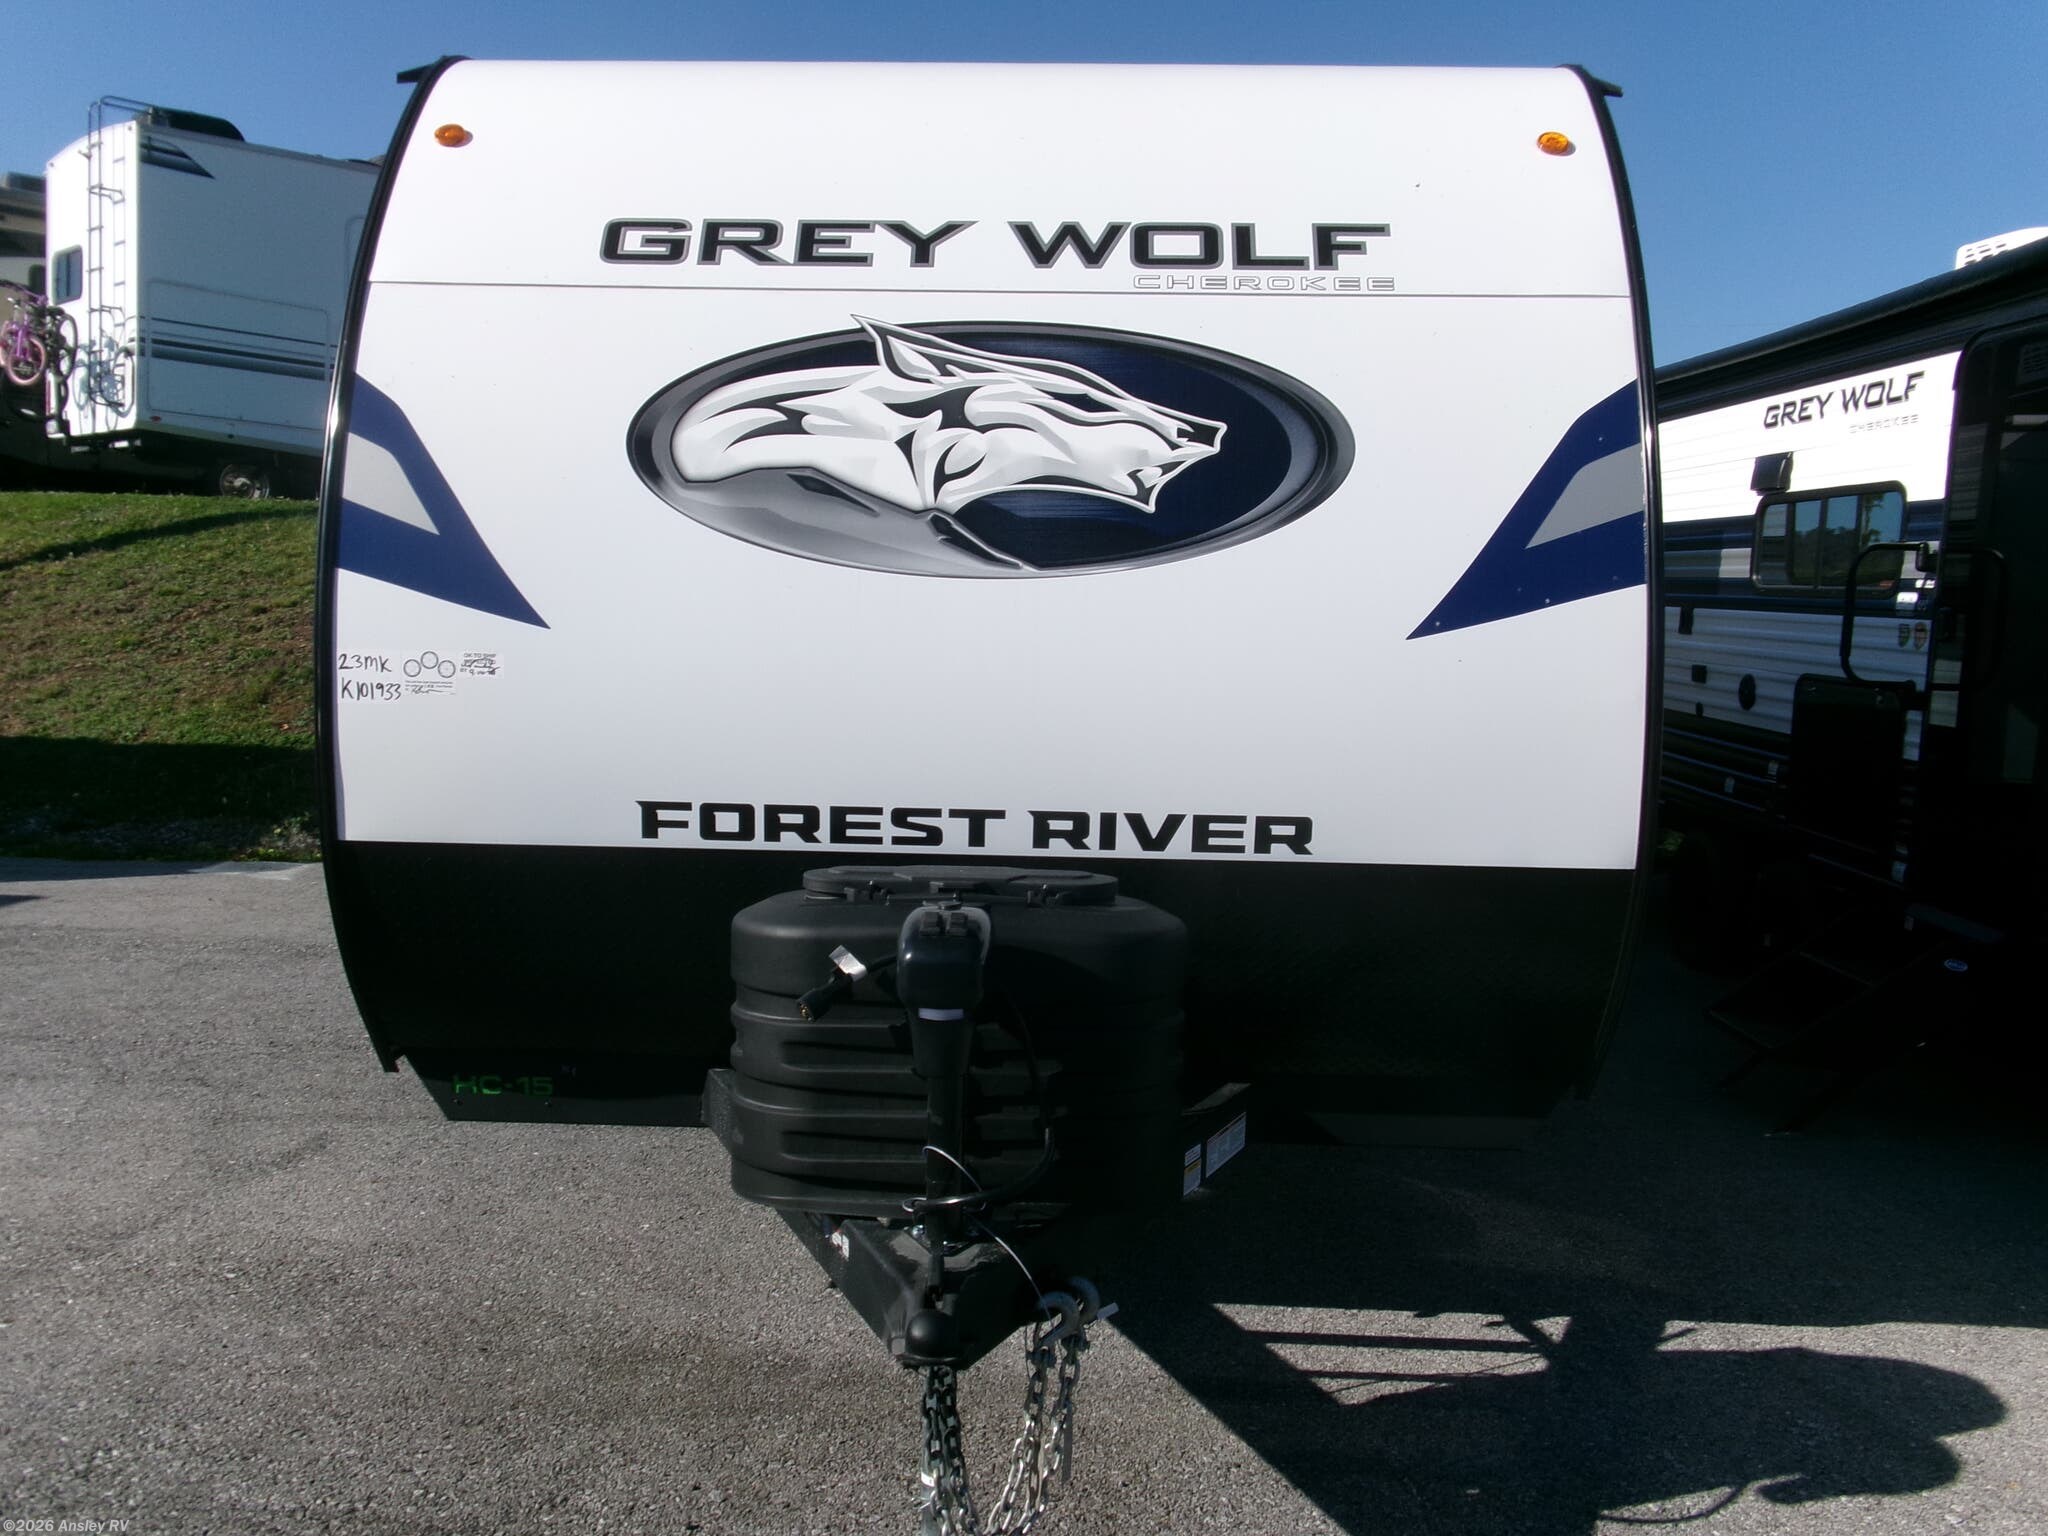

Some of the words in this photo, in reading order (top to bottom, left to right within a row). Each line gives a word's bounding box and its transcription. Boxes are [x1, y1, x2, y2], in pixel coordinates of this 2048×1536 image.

[600, 217, 980, 268] GREY
[1007, 221, 1391, 271] WOLF
[1133, 274, 1395, 291] CHEROKEE
[1764, 391, 1835, 430] GREY
[1841, 370, 1925, 414] WOLF
[1849, 414, 1919, 434] CHEROKEE
[341, 677, 402, 701] K101933
[636, 800, 1006, 847] FOREST
[1026, 809, 1314, 856] RIVER
